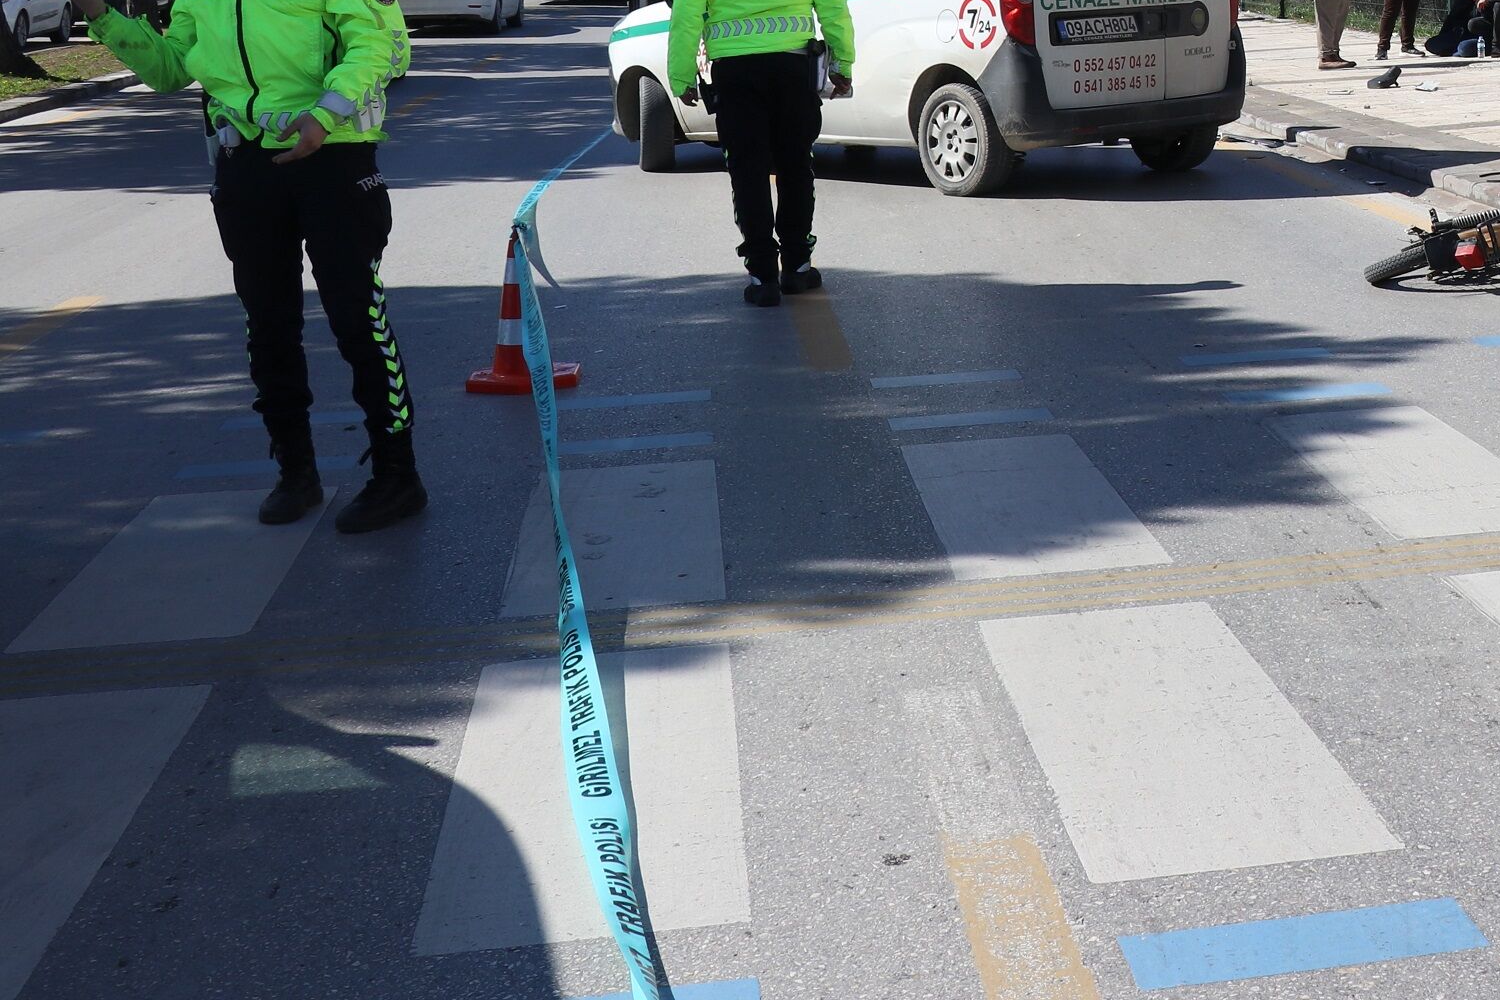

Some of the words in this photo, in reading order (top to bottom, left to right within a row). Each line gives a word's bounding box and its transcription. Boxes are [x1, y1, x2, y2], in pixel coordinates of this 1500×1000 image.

[1066, 16, 1136, 37] 09ACH804
[1073, 59, 1080, 72] 0
[1084, 58, 1104, 72] 552
[1107, 56, 1126, 71] 457
[1129, 55, 1141, 69] 04
[1145, 54, 1156, 67] 22
[1073, 80, 1080, 93] 0
[1084, 79, 1103, 93] 541
[1107, 77, 1126, 91] 385
[1129, 76, 1141, 89] 45
[1145, 75, 1156, 88] 15
[562, 628, 586, 680] POLİSİ
[566, 674, 595, 732] TRAFİK
[572, 729, 612, 797] GİRİLMEZ
[588, 817, 628, 866] POLİSİ
[603, 868, 645, 937] TRAFİK
